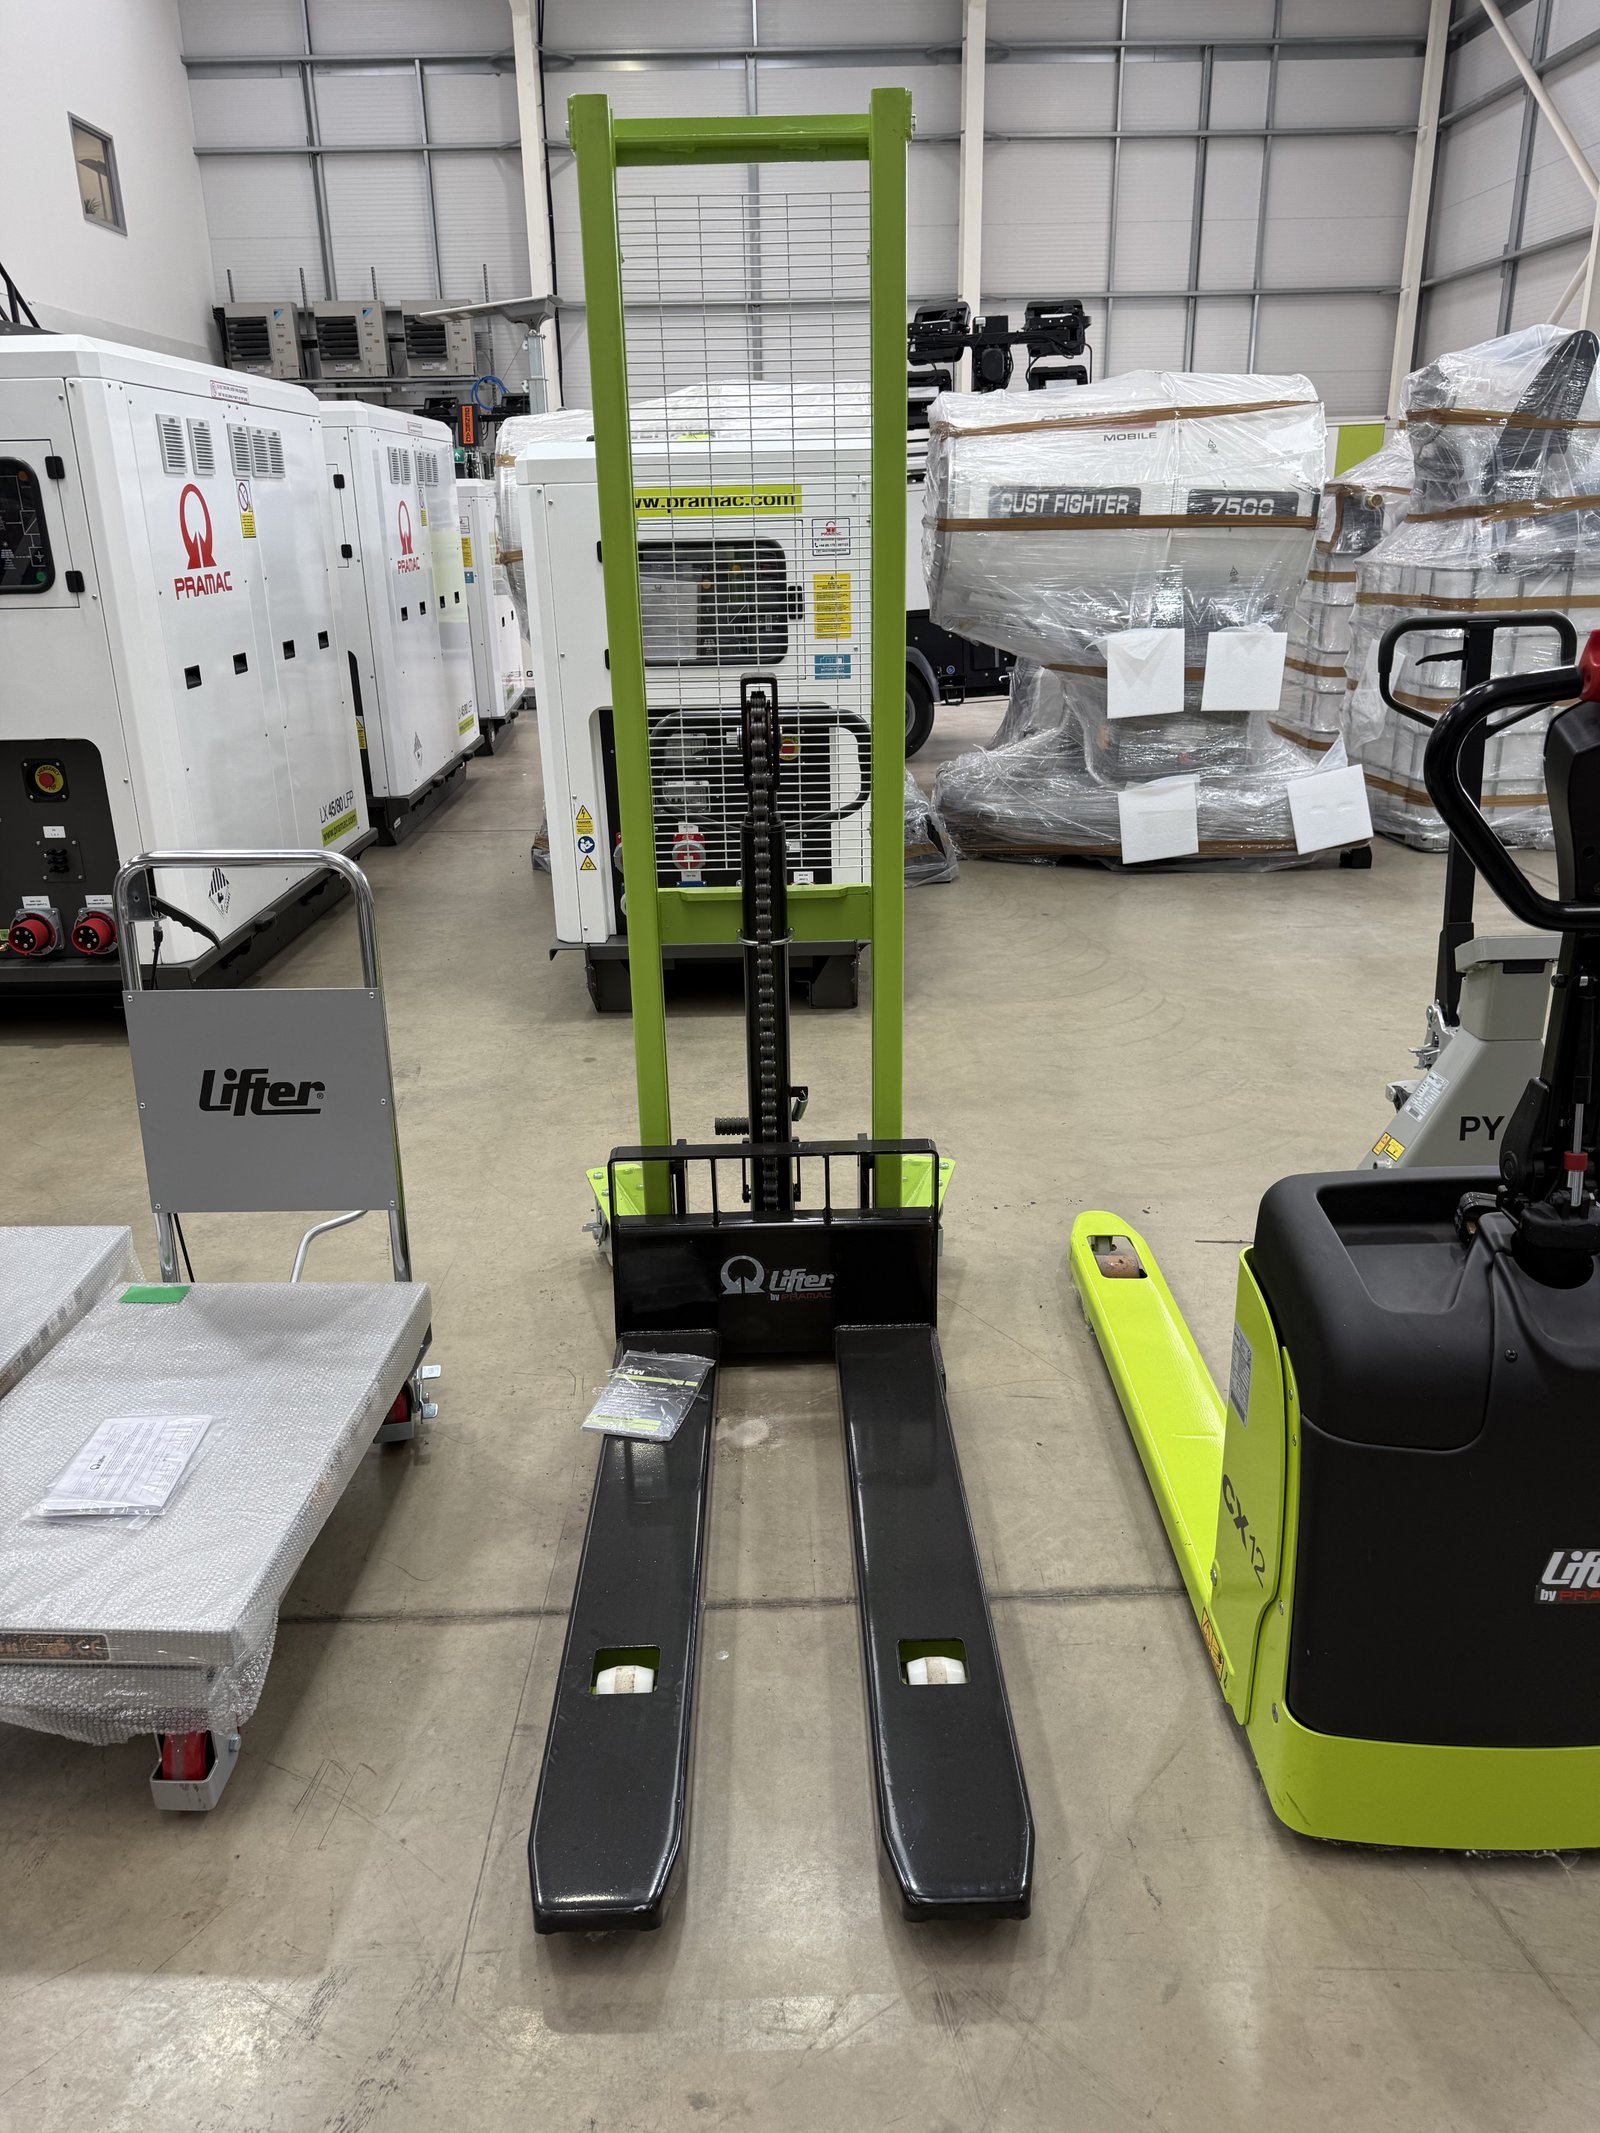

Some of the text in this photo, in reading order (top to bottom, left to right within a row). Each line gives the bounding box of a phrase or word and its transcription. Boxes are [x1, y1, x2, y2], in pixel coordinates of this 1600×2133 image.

[1103, 432, 1157, 442] MOBILE
[999, 493, 1130, 514] DUST FIGHTER
[1211, 497, 1275, 516] 7500
[397, 557, 420, 574] PRAMAC
[174, 571, 233, 600] PRAMAC
[770, 1291, 833, 1301] by PRAMAC
[1540, 1588, 1557, 1602] by
